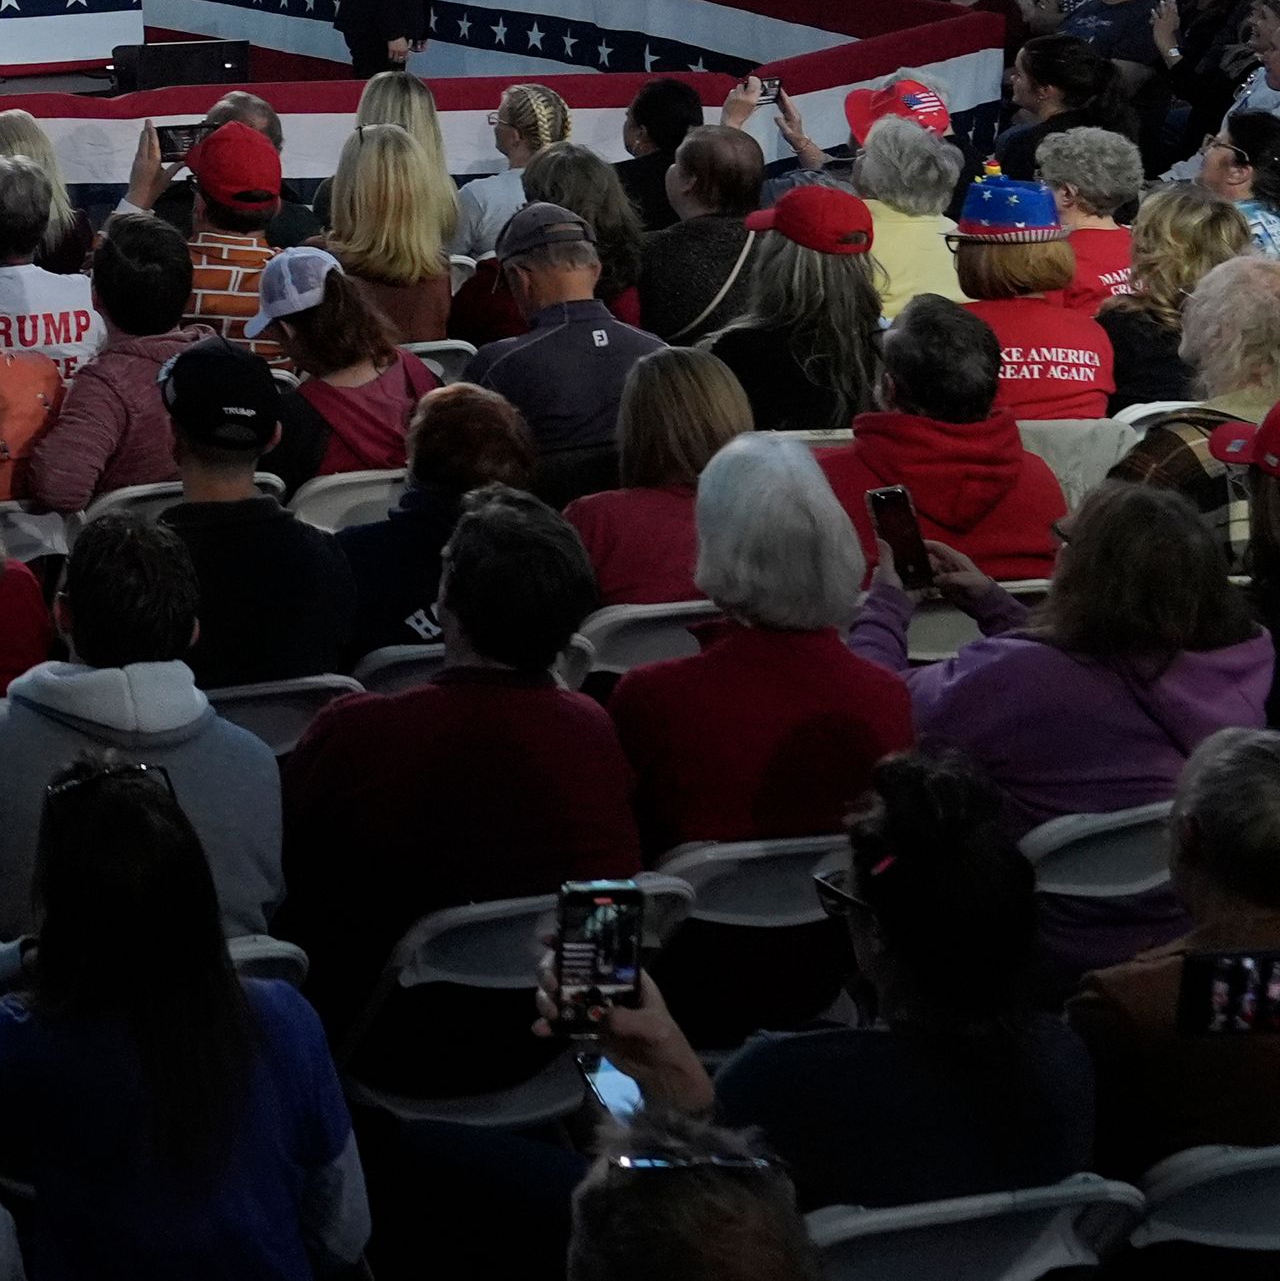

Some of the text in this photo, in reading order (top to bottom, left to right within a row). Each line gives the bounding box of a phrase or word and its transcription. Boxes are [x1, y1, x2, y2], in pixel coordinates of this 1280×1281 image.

[1027, 347, 1102, 367] AMERICA
[1047, 364, 1097, 382] AGAIN
[221, 407, 257, 417] TRUMP
